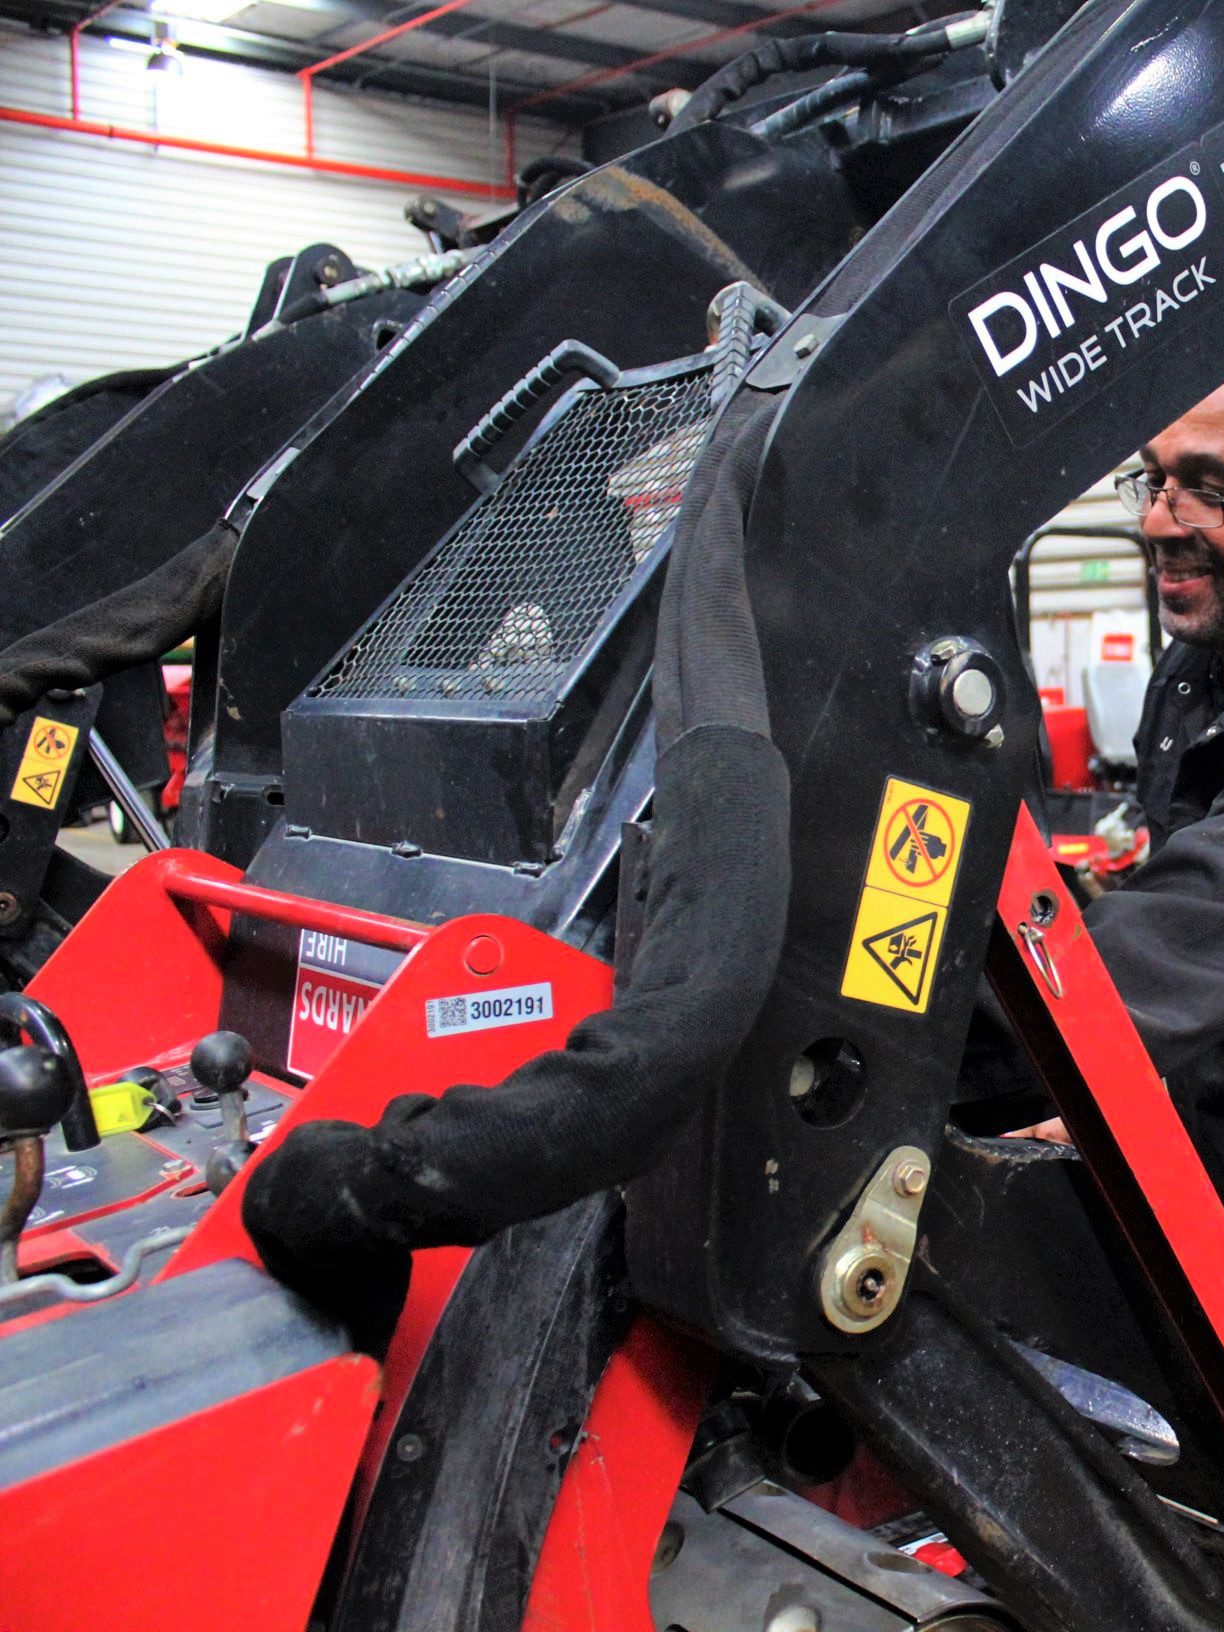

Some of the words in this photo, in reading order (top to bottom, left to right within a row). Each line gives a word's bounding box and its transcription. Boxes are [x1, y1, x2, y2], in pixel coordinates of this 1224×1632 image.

[1016, 335, 1107, 414] WIDE
[1104, 256, 1216, 350] TRACK
[470, 996, 544, 1020] 3002191
